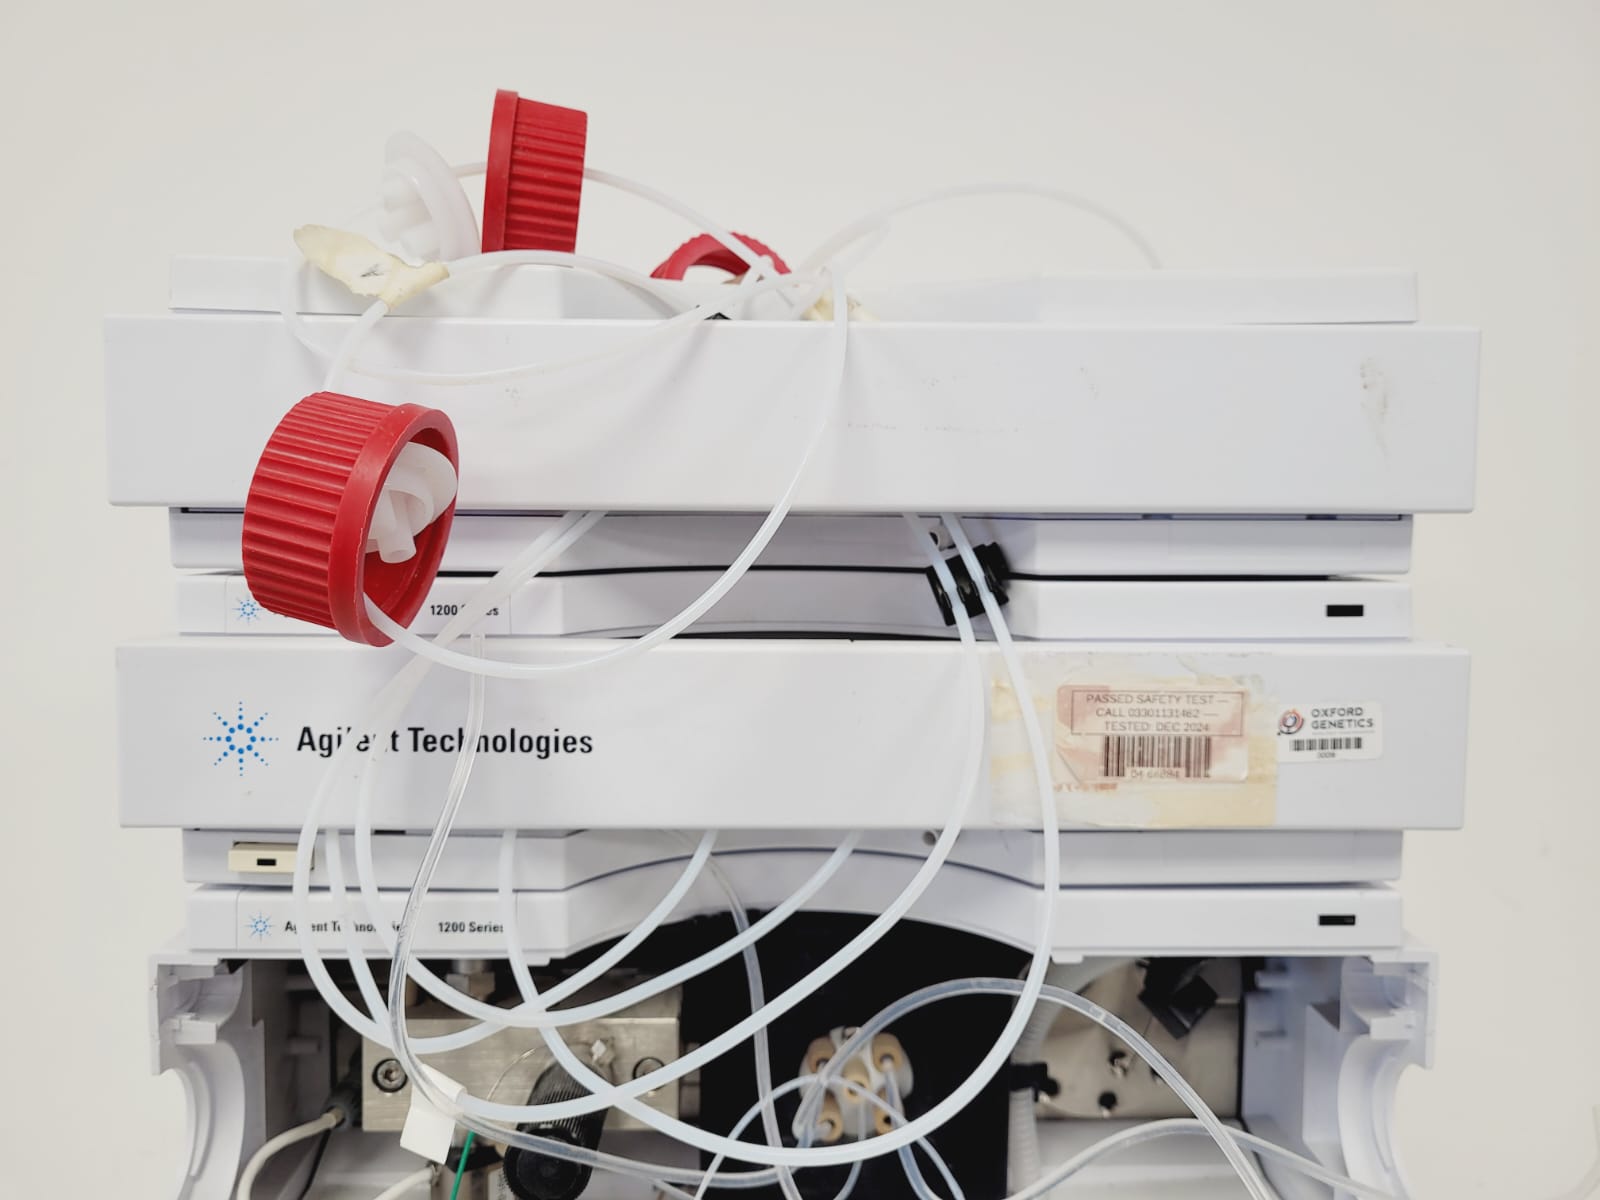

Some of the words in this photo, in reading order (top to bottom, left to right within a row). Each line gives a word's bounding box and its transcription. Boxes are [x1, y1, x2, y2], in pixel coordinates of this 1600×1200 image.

[430, 604, 458, 616] 1200
[1086, 694, 1132, 704] PASSED
[1136, 694, 1181, 704] SAFETY
[1186, 695, 1214, 705] TEST
[1096, 707, 1124, 717] CALL
[1311, 707, 1364, 718] OXFORD
[1156, 721, 1181, 732] DEC
[1311, 718, 1373, 729] GENETICS
[438, 921, 465, 933] 1200
